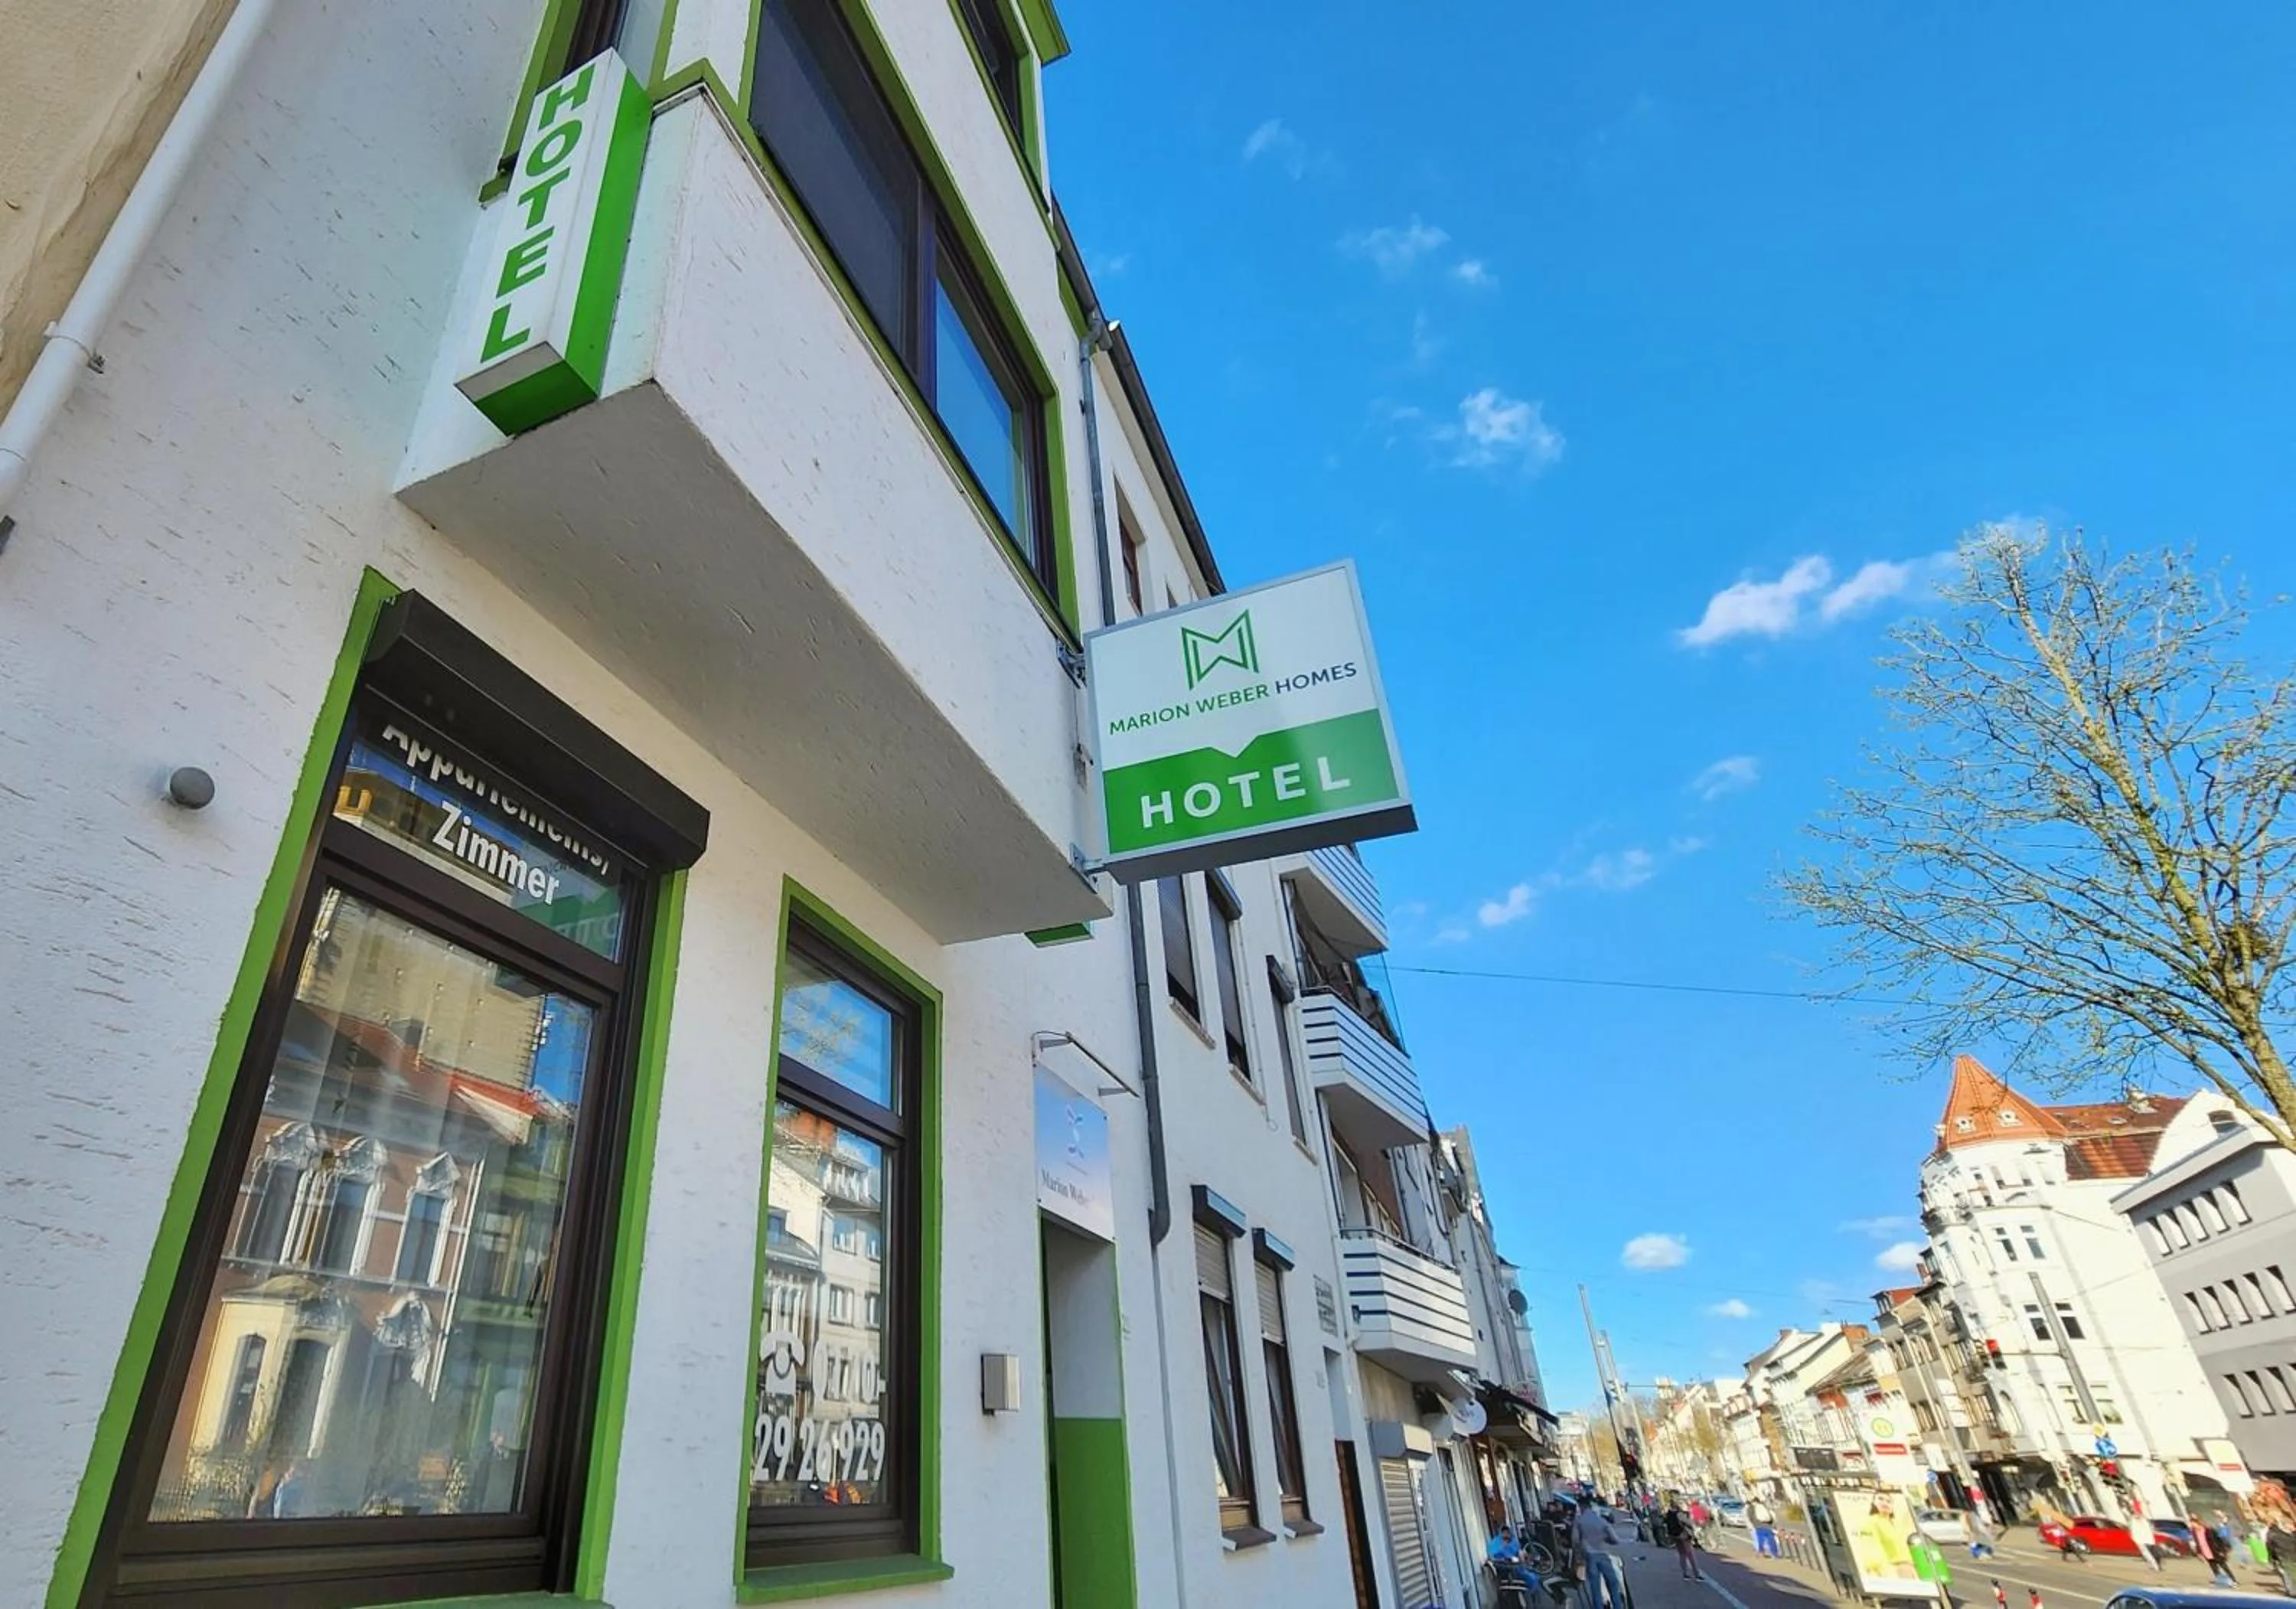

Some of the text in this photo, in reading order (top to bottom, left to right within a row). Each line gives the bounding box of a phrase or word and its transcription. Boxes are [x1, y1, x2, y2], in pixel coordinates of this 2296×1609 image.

[480, 64, 595, 364] HOTEL
[1109, 661, 1358, 736] MARION WEBER HOMES
[1140, 756, 1351, 829] HOTEL
[432, 800, 560, 906] Zimmer
[752, 1414, 886, 1483] 29 26 929
